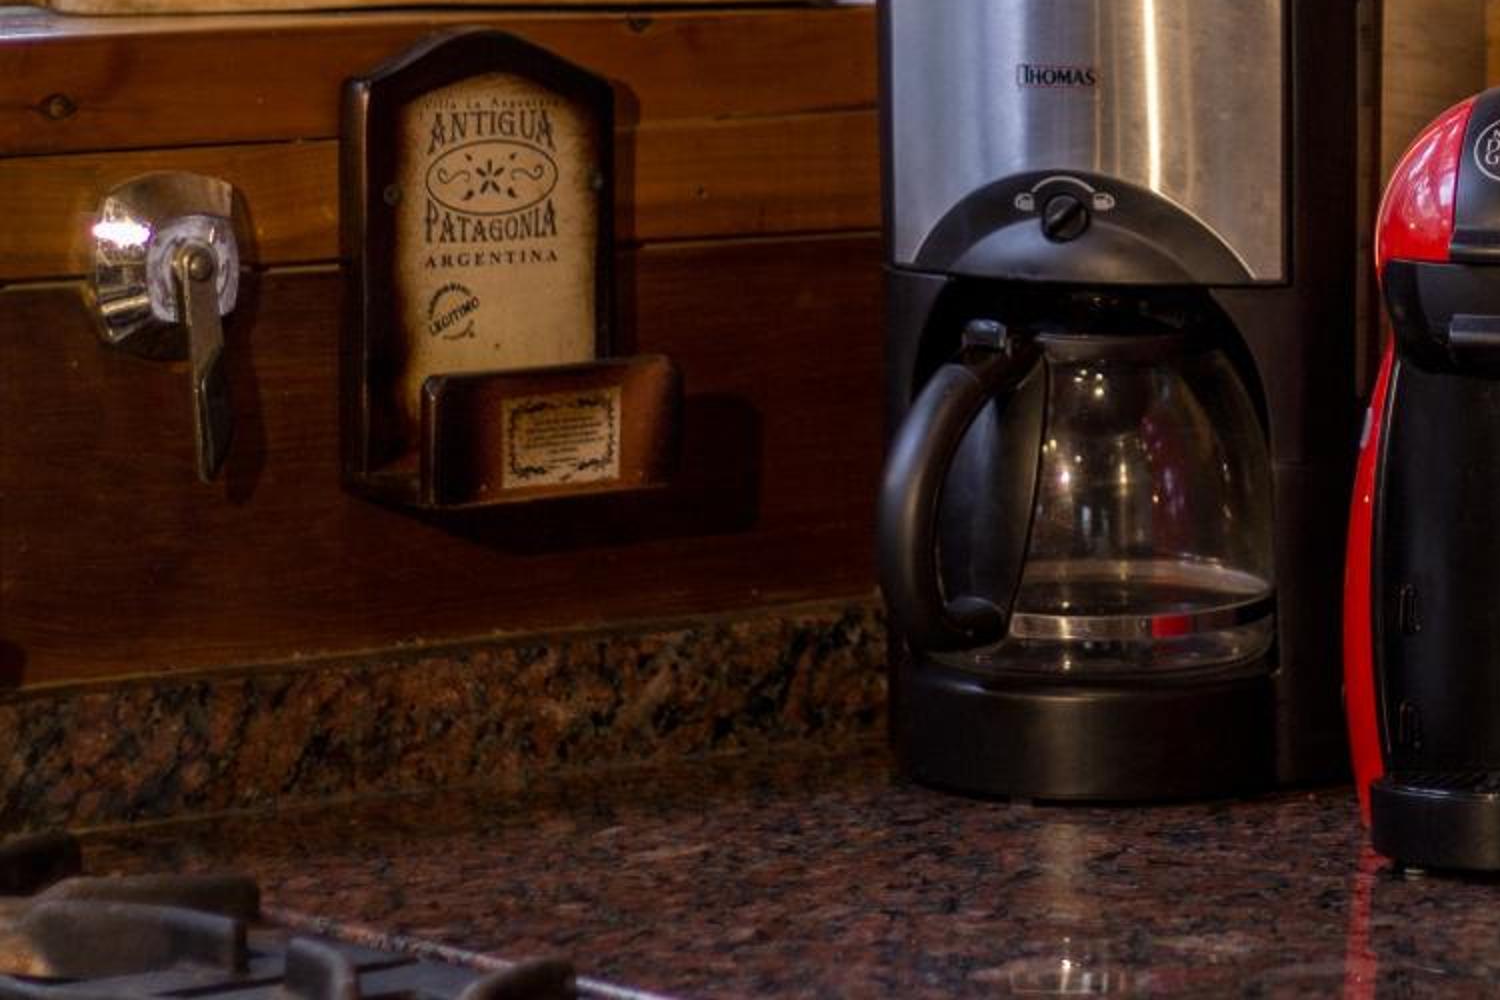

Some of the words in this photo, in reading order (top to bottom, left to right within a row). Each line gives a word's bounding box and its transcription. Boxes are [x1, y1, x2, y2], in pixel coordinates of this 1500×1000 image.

[1023, 64, 1096, 86] THOMAS
[427, 110, 557, 155] ANTIGUA
[425, 198, 558, 243] PATAGONIA
[424, 250, 558, 269] ARGENTINA
